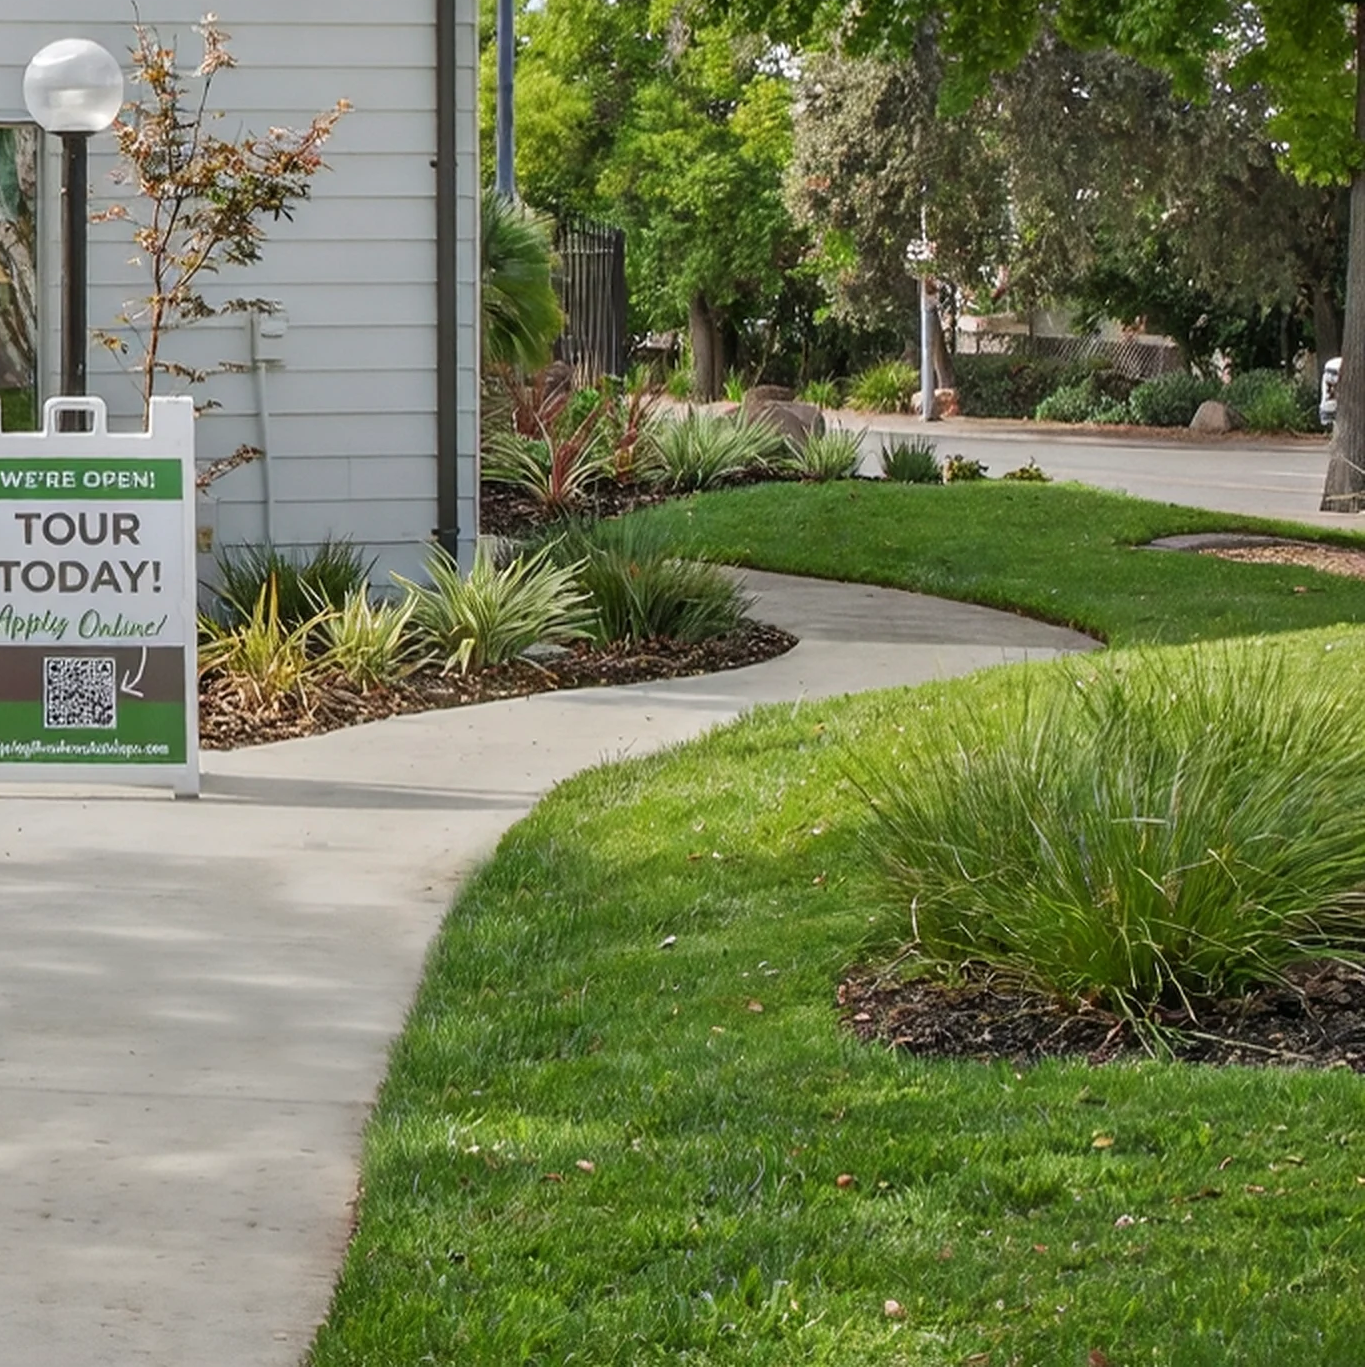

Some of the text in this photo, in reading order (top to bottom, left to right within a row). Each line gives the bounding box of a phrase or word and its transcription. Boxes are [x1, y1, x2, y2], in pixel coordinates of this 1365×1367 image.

[0, 470, 155, 489] WE'RE OPEN!
[14, 512, 140, 546] TOUR
[79, 609, 167, 639] Online!
